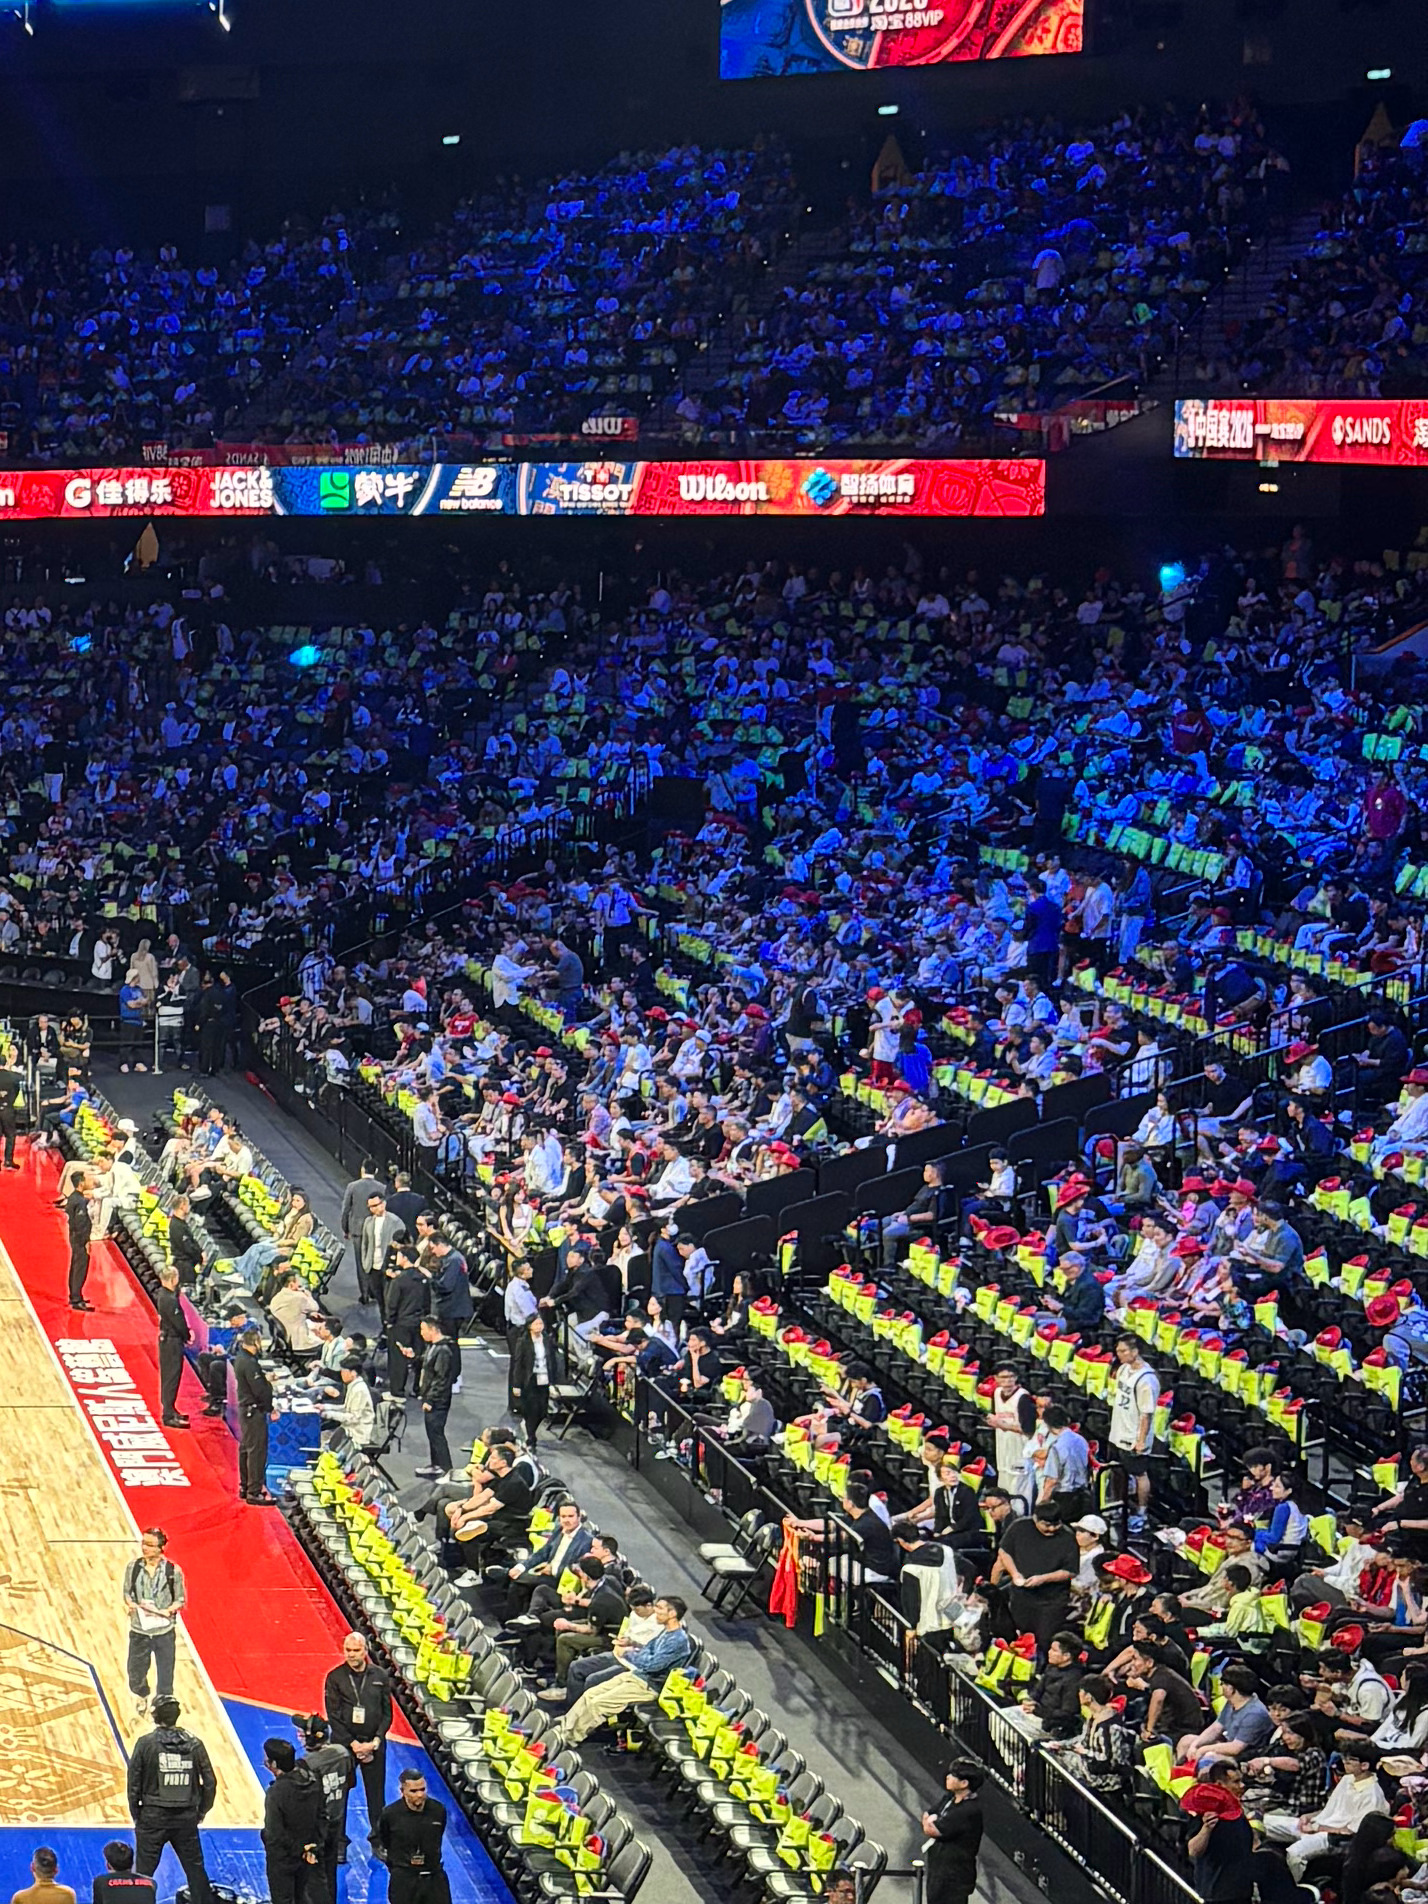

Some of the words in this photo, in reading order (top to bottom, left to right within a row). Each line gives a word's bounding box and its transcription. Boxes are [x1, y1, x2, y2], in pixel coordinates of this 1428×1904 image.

[1346, 417, 1392, 444] SANDS
[210, 467, 272, 489] JACK&
[679, 473, 771, 501] Wilson
[95, 478, 173, 505] 佳得乐
[210, 488, 273, 508] JONES
[561, 484, 634, 502] TISSOT
